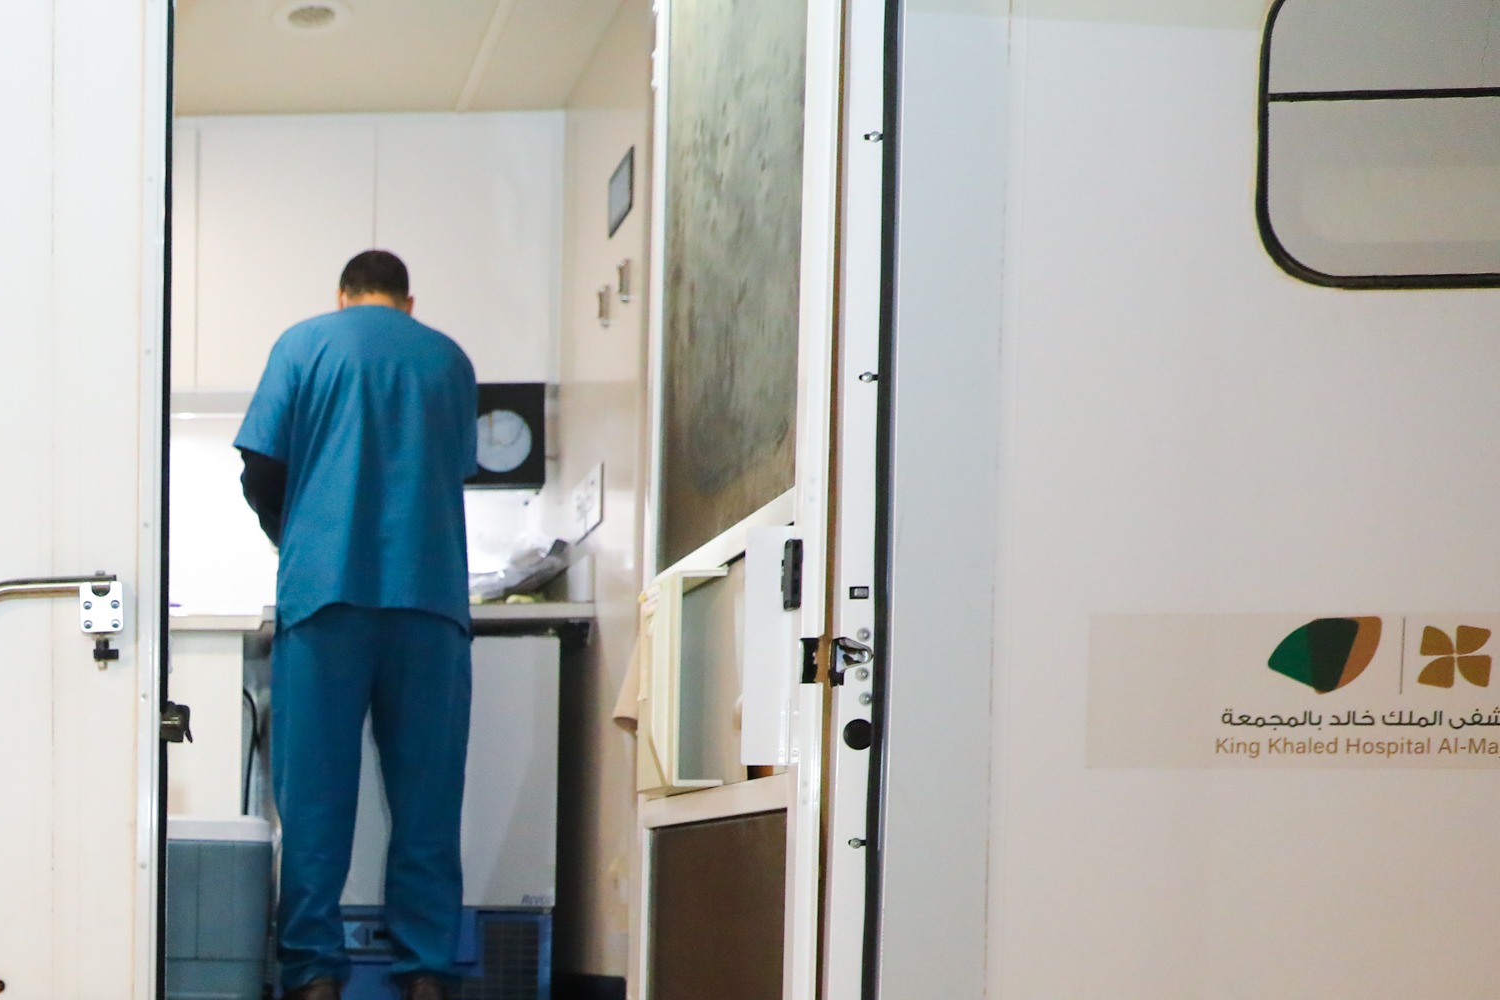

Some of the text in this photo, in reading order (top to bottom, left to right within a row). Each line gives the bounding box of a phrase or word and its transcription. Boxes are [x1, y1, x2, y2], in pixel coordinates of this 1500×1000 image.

[1221, 709, 1322, 729] بالمجمعة
[1328, 709, 1376, 727] خالد
[1381, 710, 1443, 728] الملك
[1215, 736, 1500, 759] King Khaled Hospital Al-Ma
